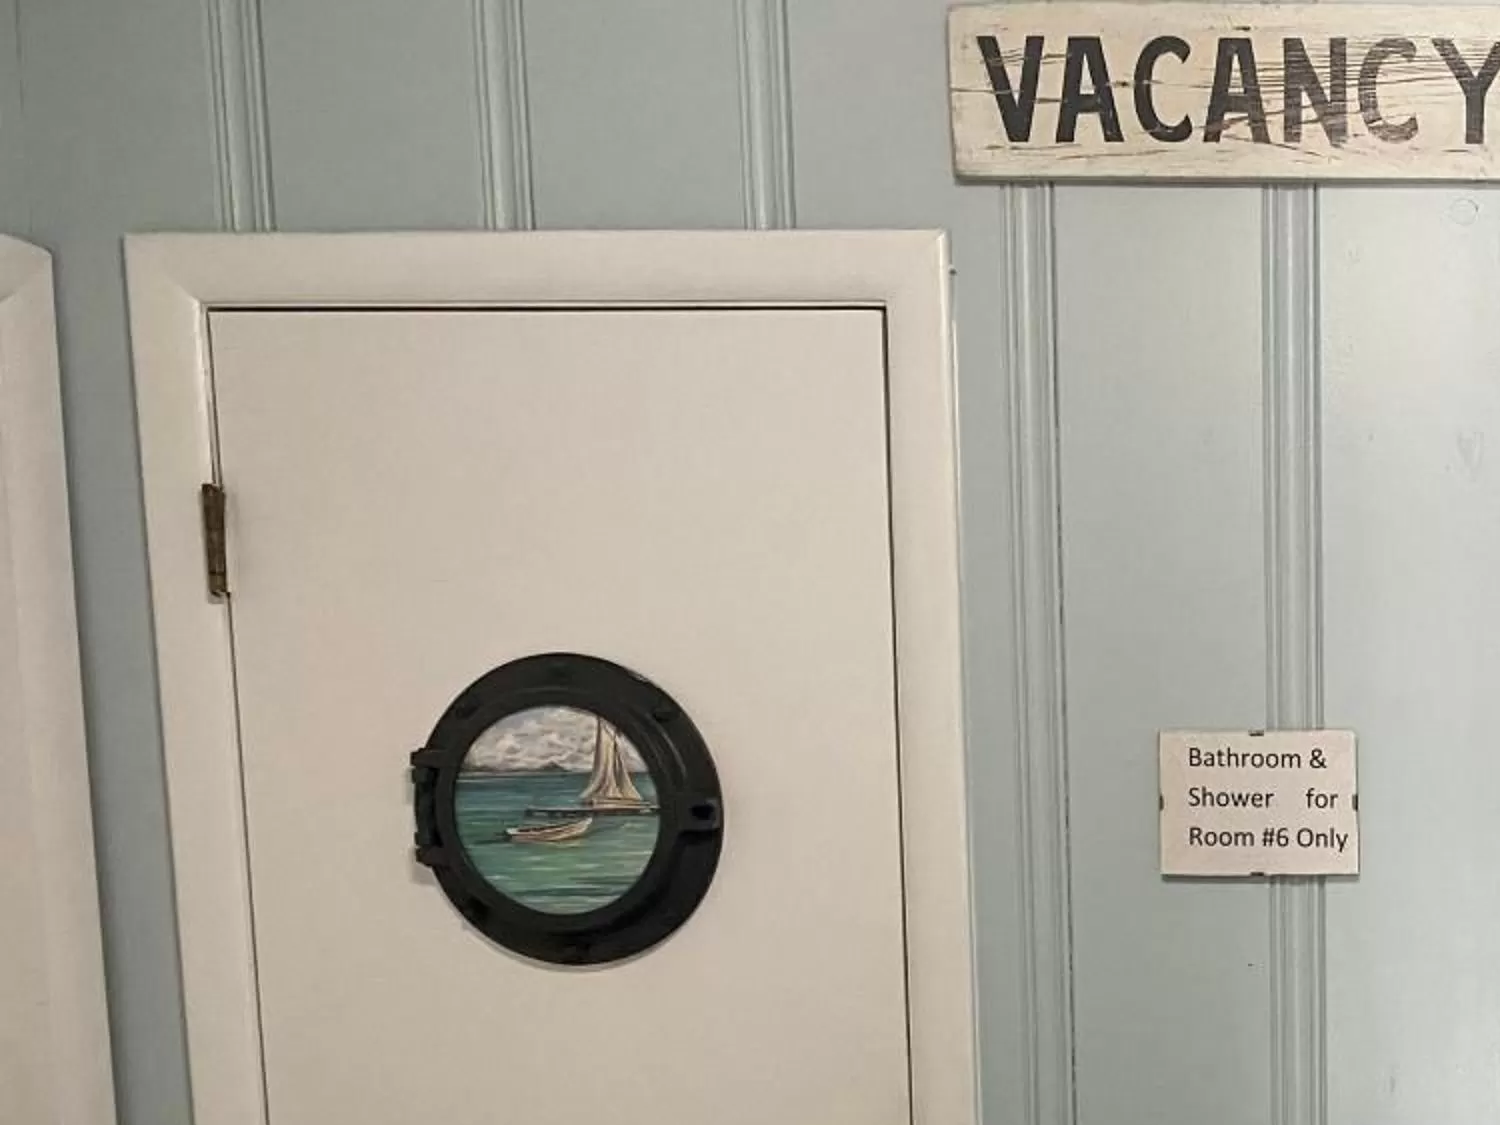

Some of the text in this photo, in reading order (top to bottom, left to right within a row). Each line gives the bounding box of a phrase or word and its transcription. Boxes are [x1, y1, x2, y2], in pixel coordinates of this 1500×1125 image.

[1188, 747, 1328, 769] Bathroom &
[1187, 786, 1339, 809] Shower for
[1188, 827, 1349, 852] Room #6 Only
